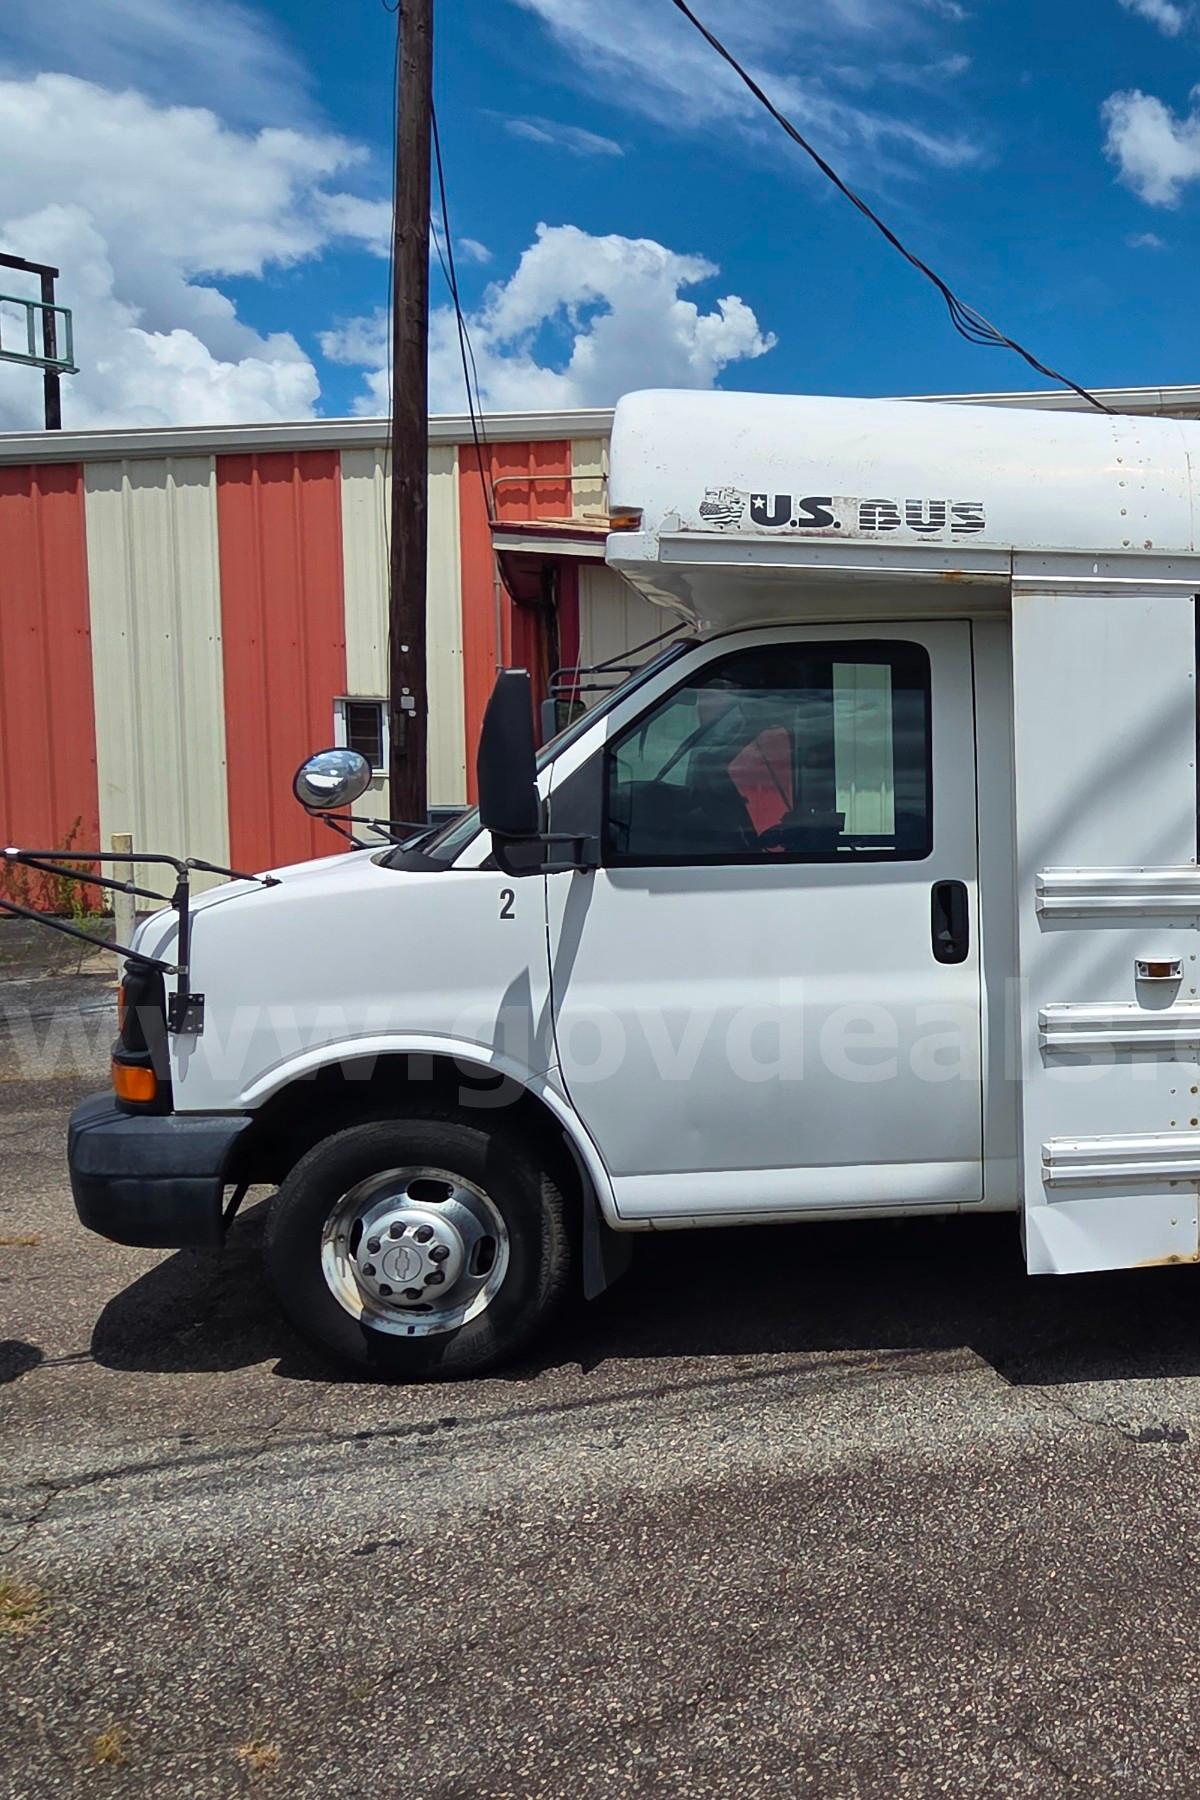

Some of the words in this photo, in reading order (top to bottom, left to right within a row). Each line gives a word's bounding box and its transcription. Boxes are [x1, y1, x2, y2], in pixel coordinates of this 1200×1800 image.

[749, 493, 841, 528] U.S.
[859, 497, 986, 534] BUS
[499, 888, 515, 919] 2
